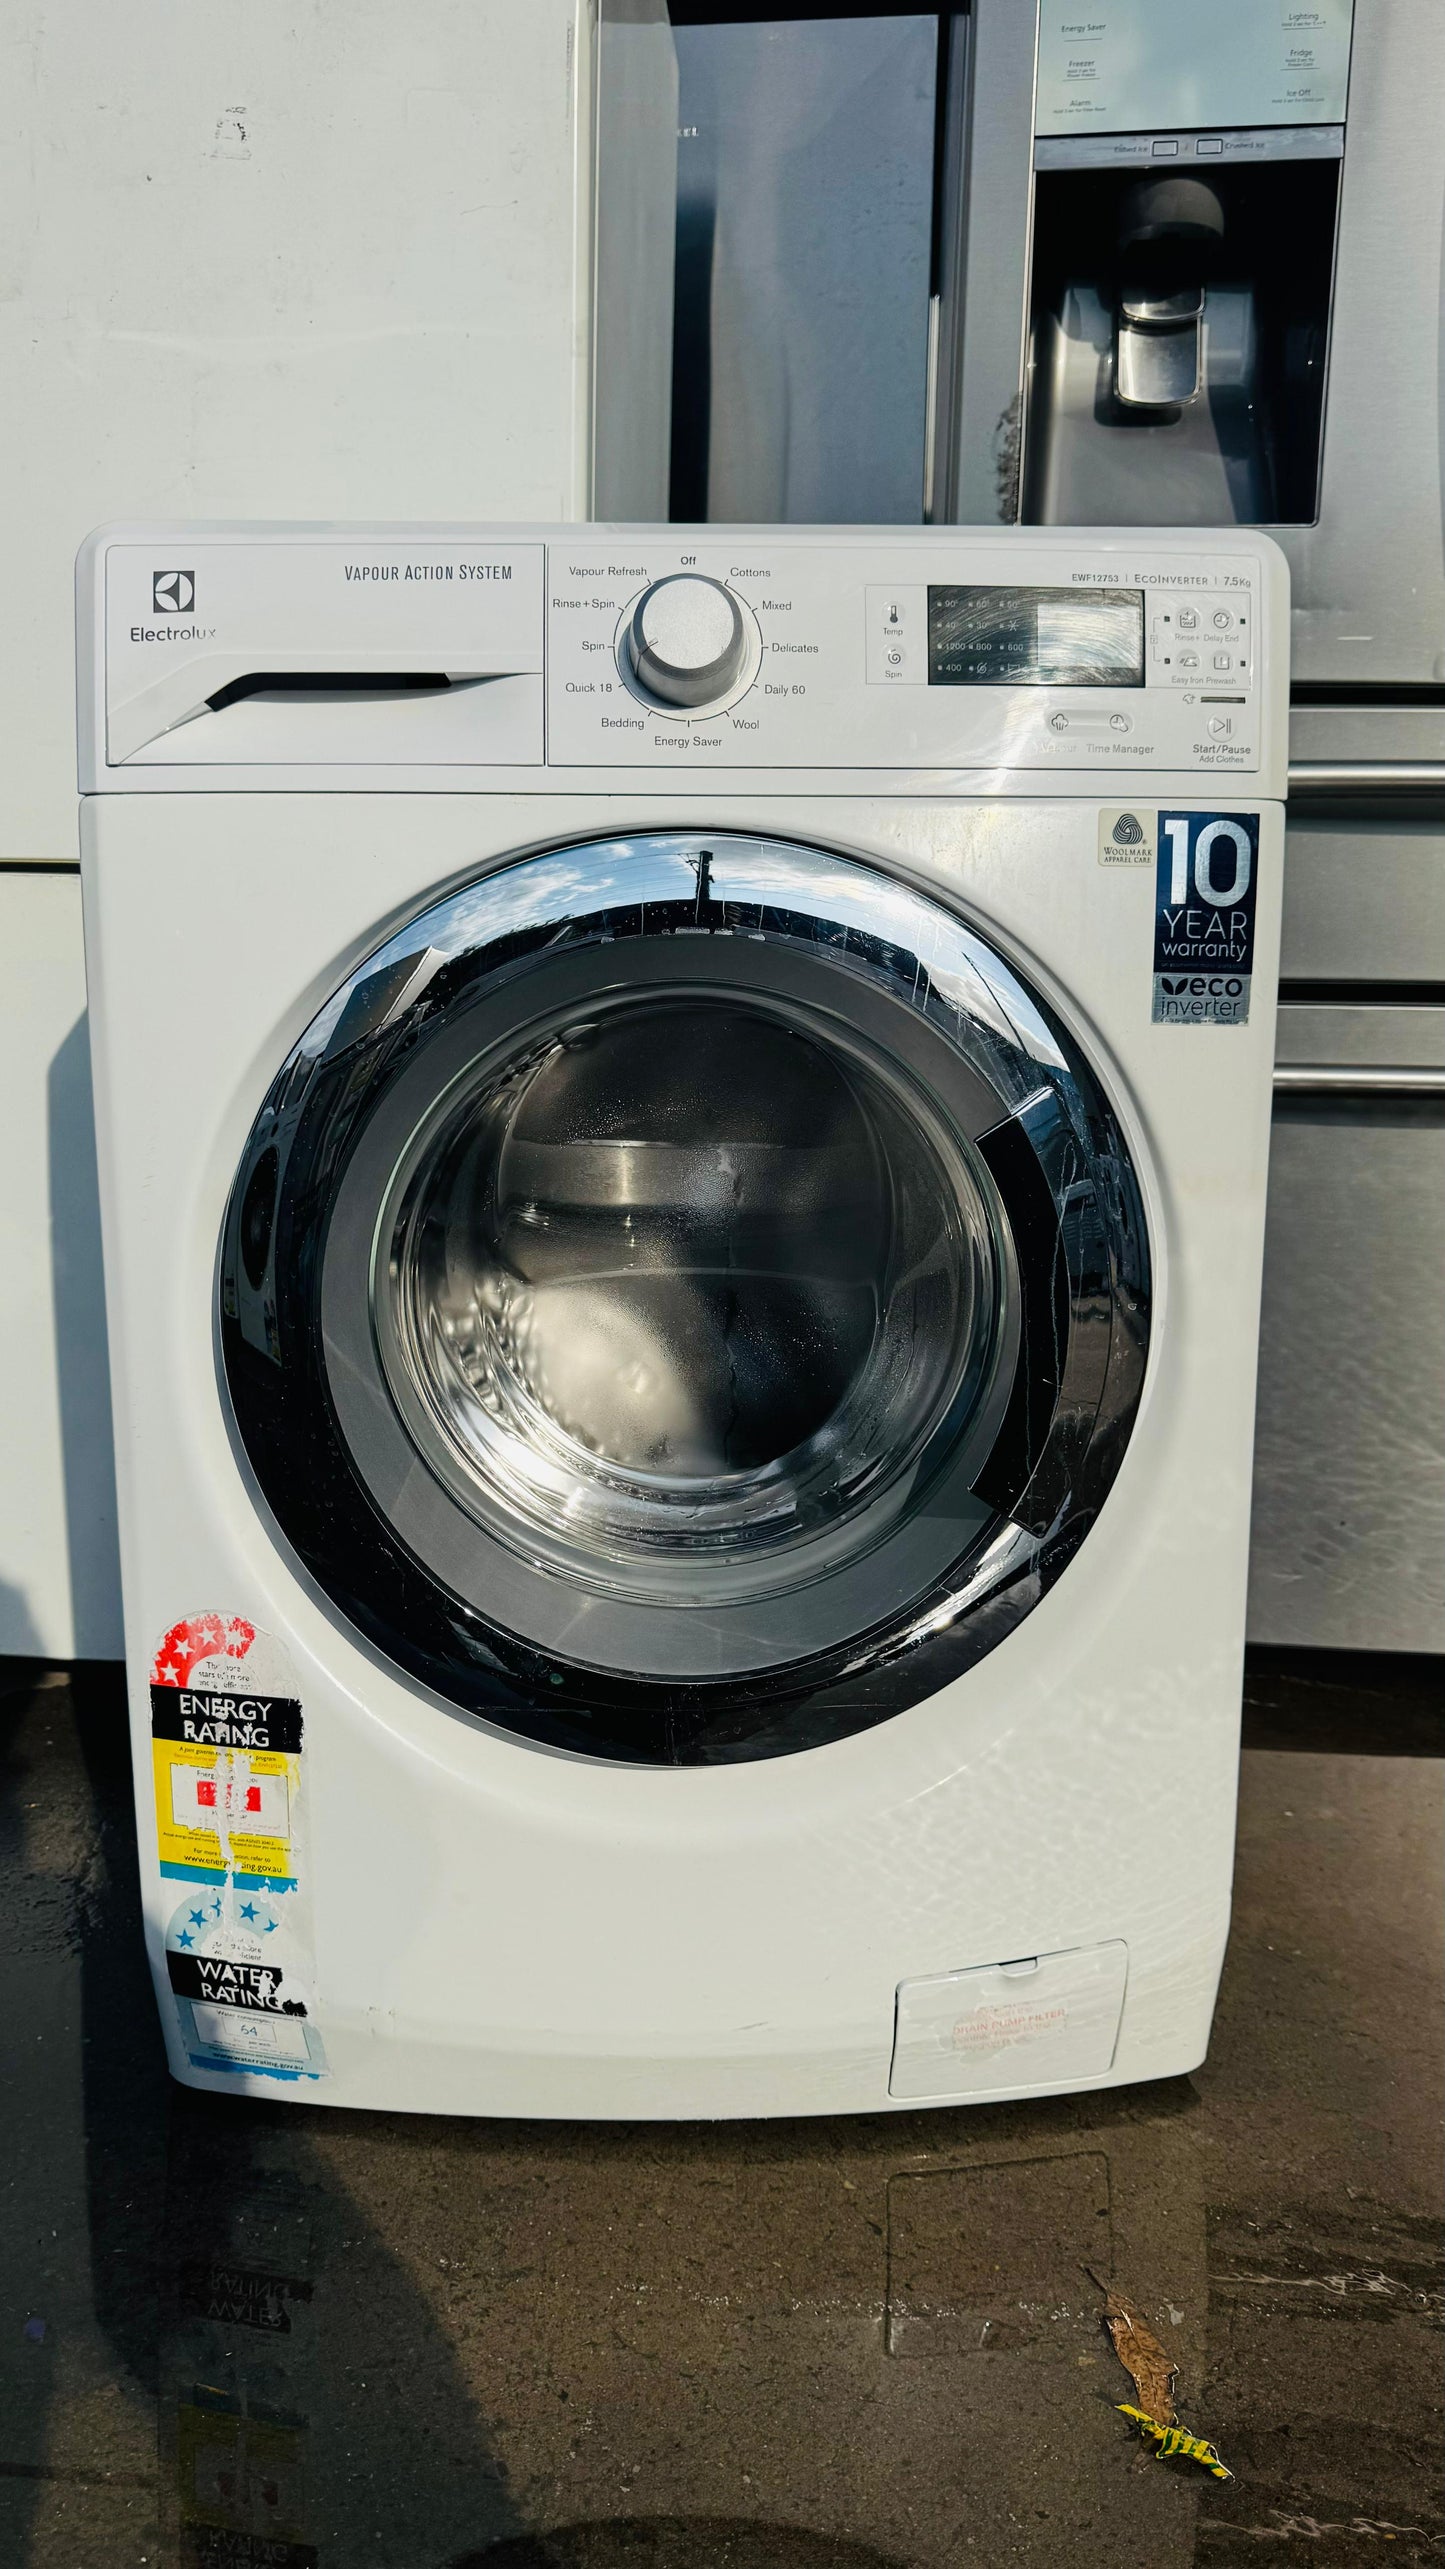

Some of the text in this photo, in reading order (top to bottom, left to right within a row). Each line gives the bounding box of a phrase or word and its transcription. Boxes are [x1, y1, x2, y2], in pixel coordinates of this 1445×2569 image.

[1061, 25, 1085, 33] Energy
[1290, 49, 1313, 57] Fridge
[680, 556, 696, 565] Off
[344, 564, 512, 581] VAPOUR ACTION SYSTEM
[568, 566, 647, 577] Vapour Refresh
[730, 567, 771, 577] Cottons
[1072, 573, 1119, 583] EWF12753
[762, 600, 792, 611] Mixed
[130, 626, 216, 642] Electrolux
[883, 627, 903, 637] Temp
[1203, 634, 1224, 643] Delay
[581, 641, 605, 652] Spin
[772, 643, 819, 654] Delicates
[946, 664, 962, 672] 400
[885, 670, 903, 679] Spin
[1171, 675, 1188, 685] Easy
[1206, 677, 1236, 685] Prewash
[565, 683, 613, 693] Quick 18
[764, 684, 806, 697] Daily 60
[601, 718, 645, 730] Bedding
[732, 719, 760, 730] Wool
[654, 736, 722, 748] Energy Saver
[1086, 744, 1155, 756] Time Manager
[1193, 744, 1251, 755] Start/Pause
[1199, 755, 1244, 764] Add Clothes
[1104, 846, 1153, 857] WOOLMARK
[1104, 856, 1132, 864] APPAREL
[1164, 819, 1251, 908] 10
[1162, 909, 1247, 940] YEAR
[1162, 940, 1247, 962] warranty
[1189, 977, 1243, 997] eco
[1161, 997, 1241, 1016] inverter
[180, 1694, 272, 1721] ENERGY
[183, 1720, 270, 1747] RATING
[196, 1959, 277, 1989] WATER
[201, 1982, 283, 2011] RATING
[1028, 2008, 1066, 2024] FILTER
